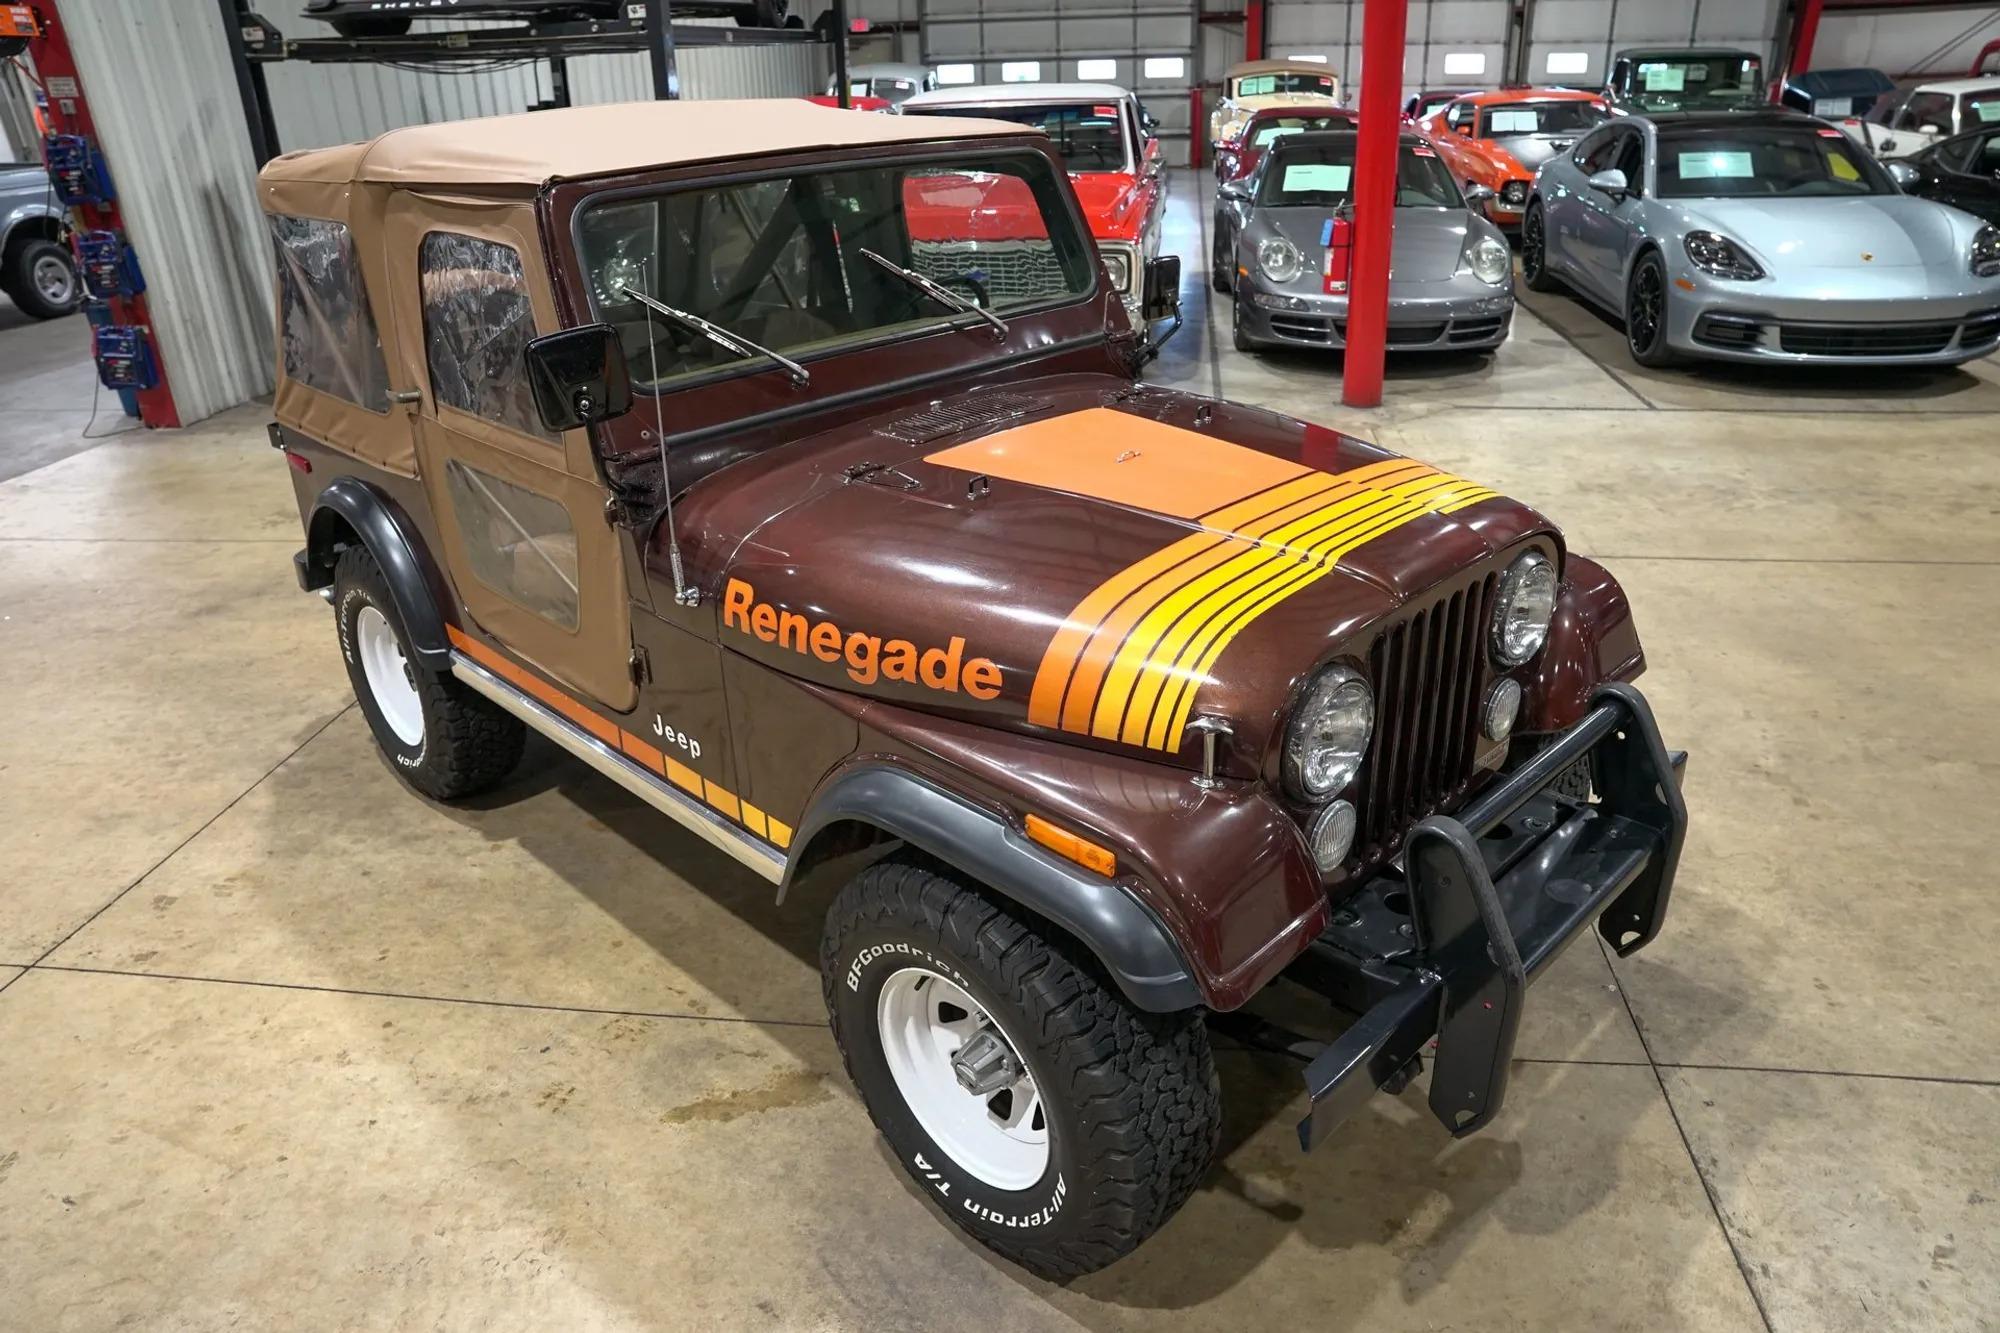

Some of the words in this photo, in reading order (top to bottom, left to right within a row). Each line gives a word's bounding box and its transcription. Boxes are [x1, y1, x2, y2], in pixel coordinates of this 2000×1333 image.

[723, 578, 1003, 701] Renegade
[653, 713, 701, 759] Jeep
[846, 942, 970, 992] BFGoodrich
[914, 1152, 951, 1197] T/A
[964, 1172, 1067, 1228] All-Terrain
